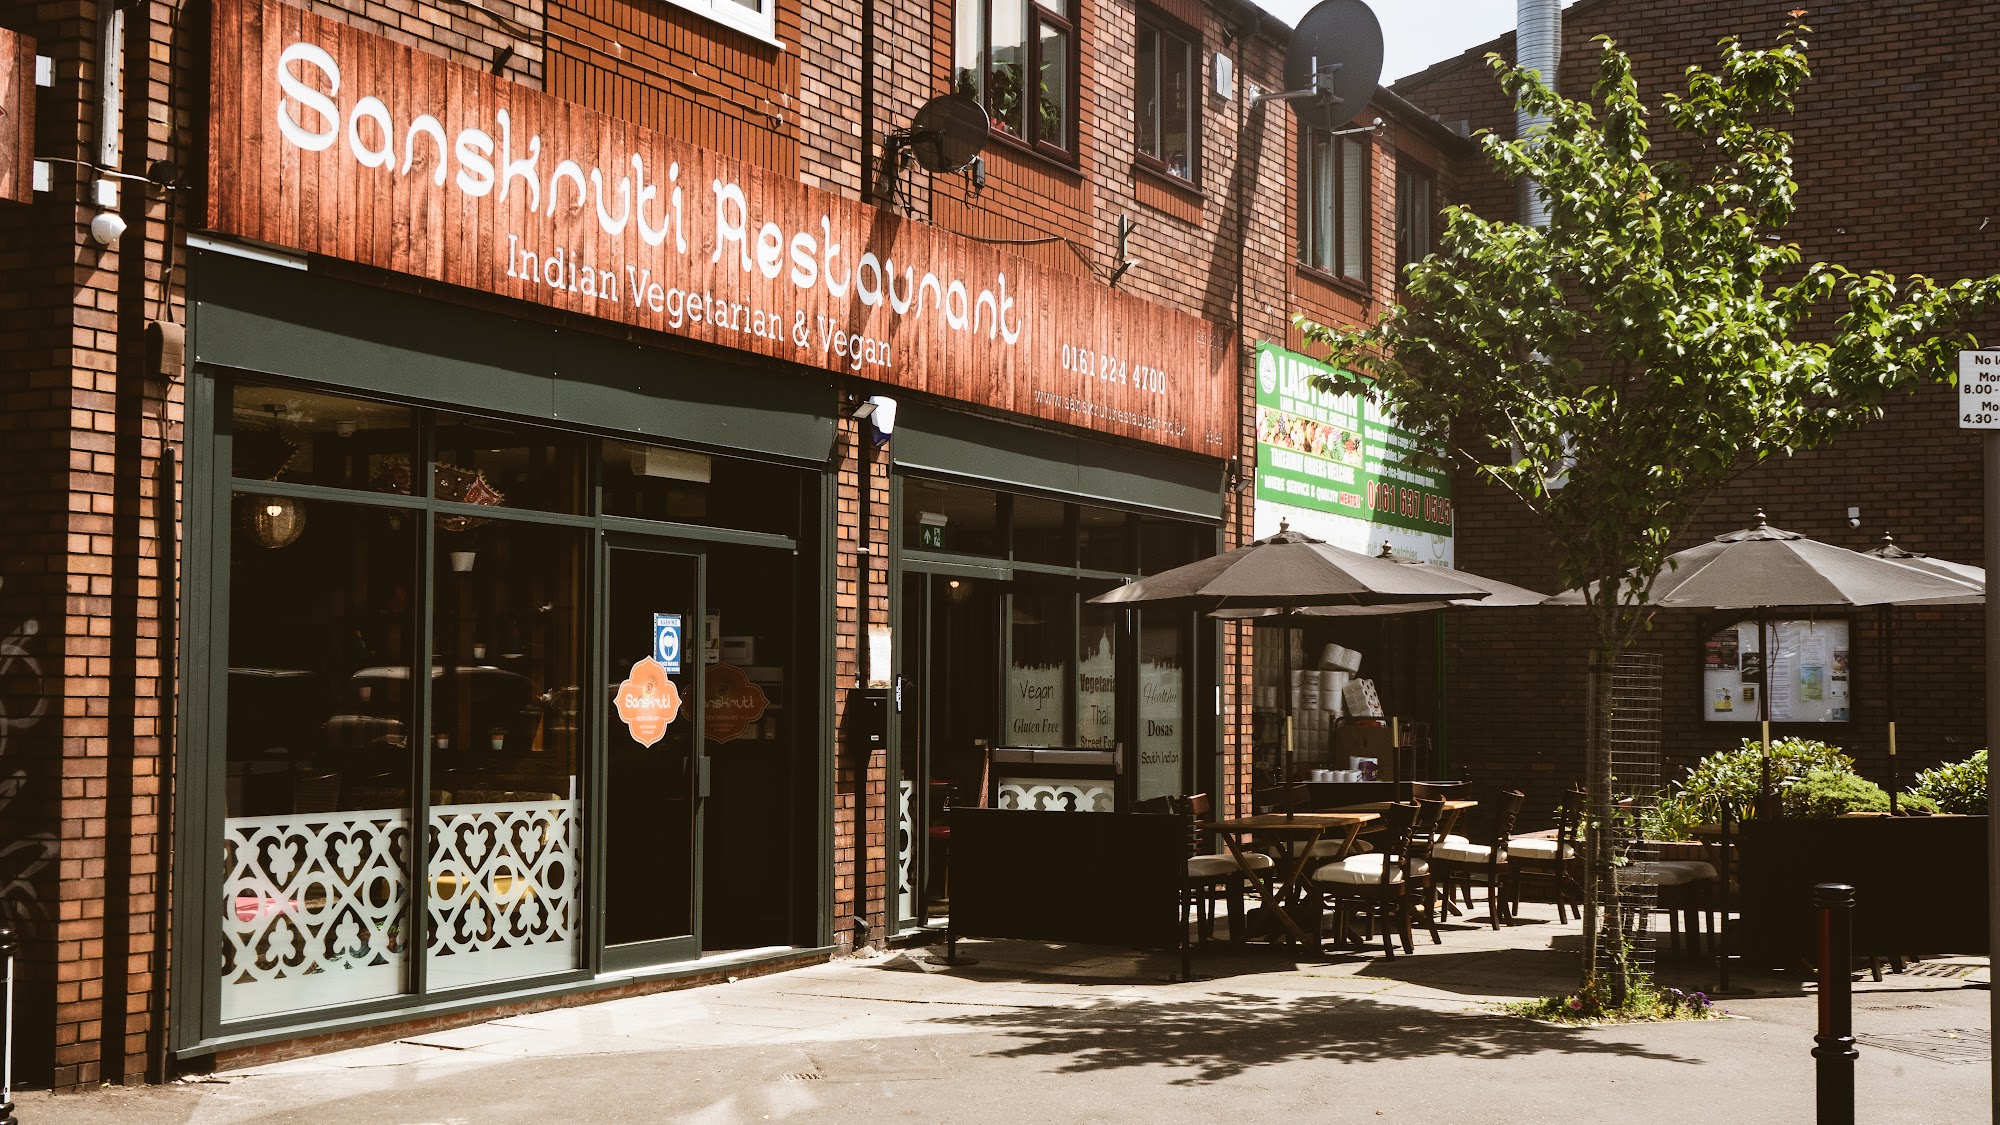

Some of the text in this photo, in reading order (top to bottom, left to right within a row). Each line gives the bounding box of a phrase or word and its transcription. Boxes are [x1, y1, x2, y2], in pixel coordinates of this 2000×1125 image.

[277, 42, 1022, 345] Sanskruti Restaurant
[507, 233, 892, 370] Indian Vegetarian & Vegan
[1975, 355, 1991, 365] No
[1062, 343, 1167, 395] 0161 224 4700
[1964, 384, 1992, 394] 8.00
[1963, 413, 1992, 424] 4.30
[1367, 480, 1396, 514] 0161
[1400, 487, 1420, 518] 637
[1424, 493, 1451, 525] 0525
[625, 694, 671, 709] Sanskruti
[1020, 680, 1054, 711] Vegan
[1014, 719, 1059, 734] Gluten Free
[1147, 720, 1173, 736] Dosas
[1081, 735, 1102, 748] Street
[1141, 751, 1178, 764] South Indian
